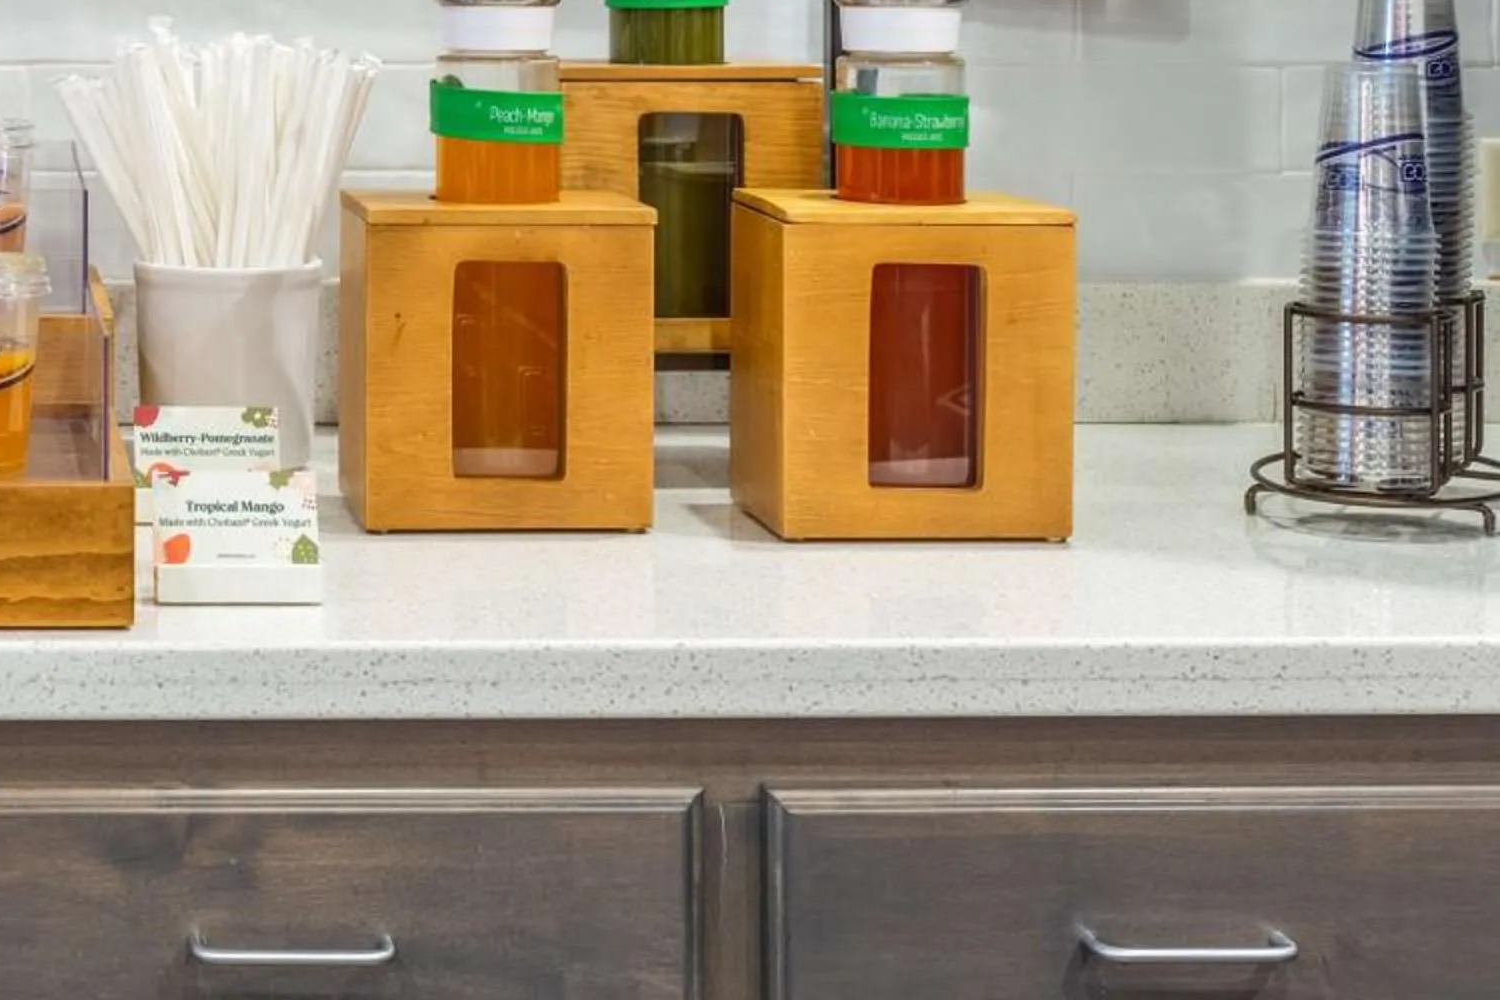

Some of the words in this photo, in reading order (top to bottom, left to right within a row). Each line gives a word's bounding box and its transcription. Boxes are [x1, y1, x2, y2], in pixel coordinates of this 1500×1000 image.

[185, 500, 239, 514] Tropical
[241, 500, 286, 515] Mango
[158, 517, 184, 527] Made
